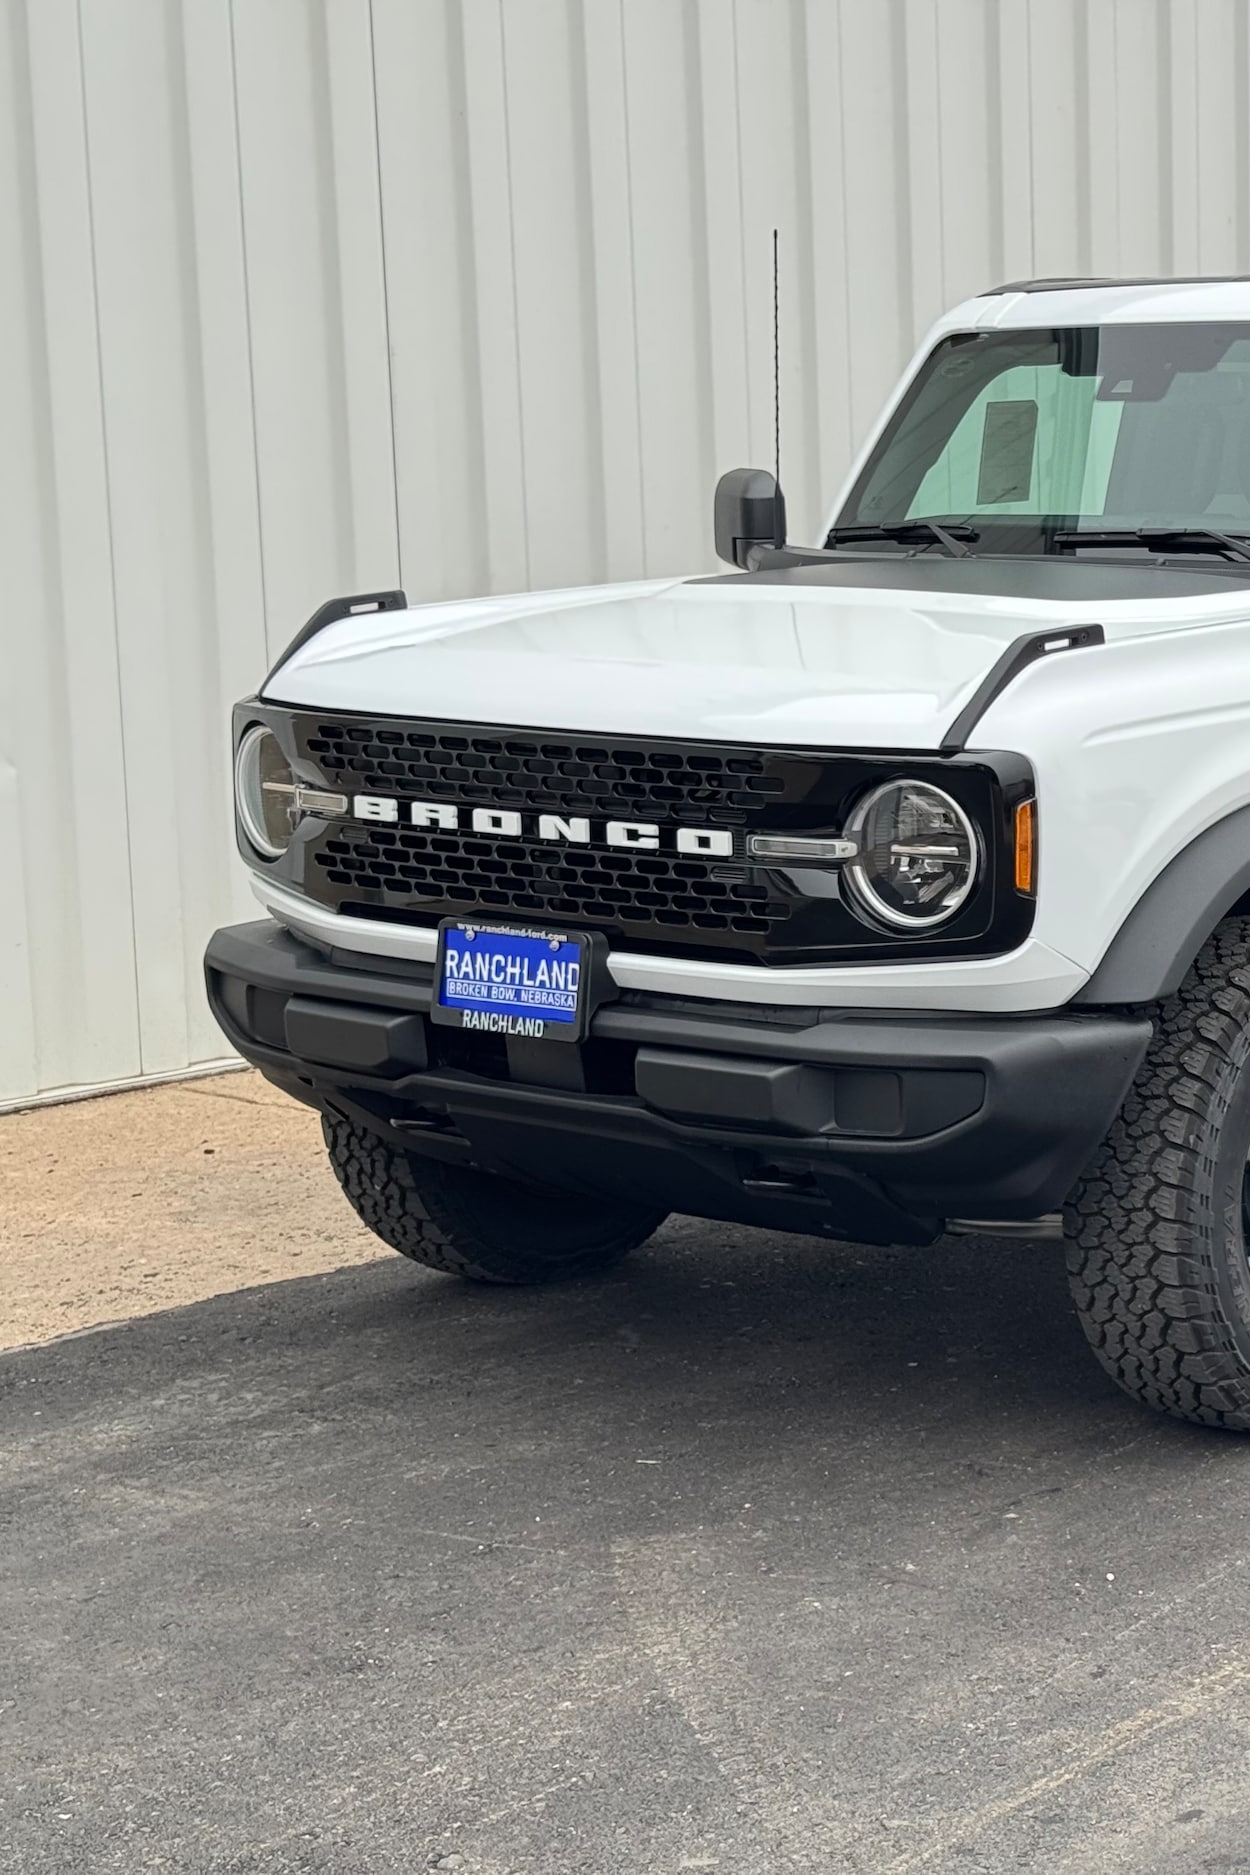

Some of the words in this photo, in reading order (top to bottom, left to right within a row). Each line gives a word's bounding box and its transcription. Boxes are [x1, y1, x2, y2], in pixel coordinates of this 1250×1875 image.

[353, 794, 733, 857] BRONCO
[445, 949, 580, 992] RANCHLAND
[449, 981, 487, 998] BROKEN
[521, 990, 575, 1008] NEBRASKA
[462, 1009, 544, 1038] RANCHLAND
